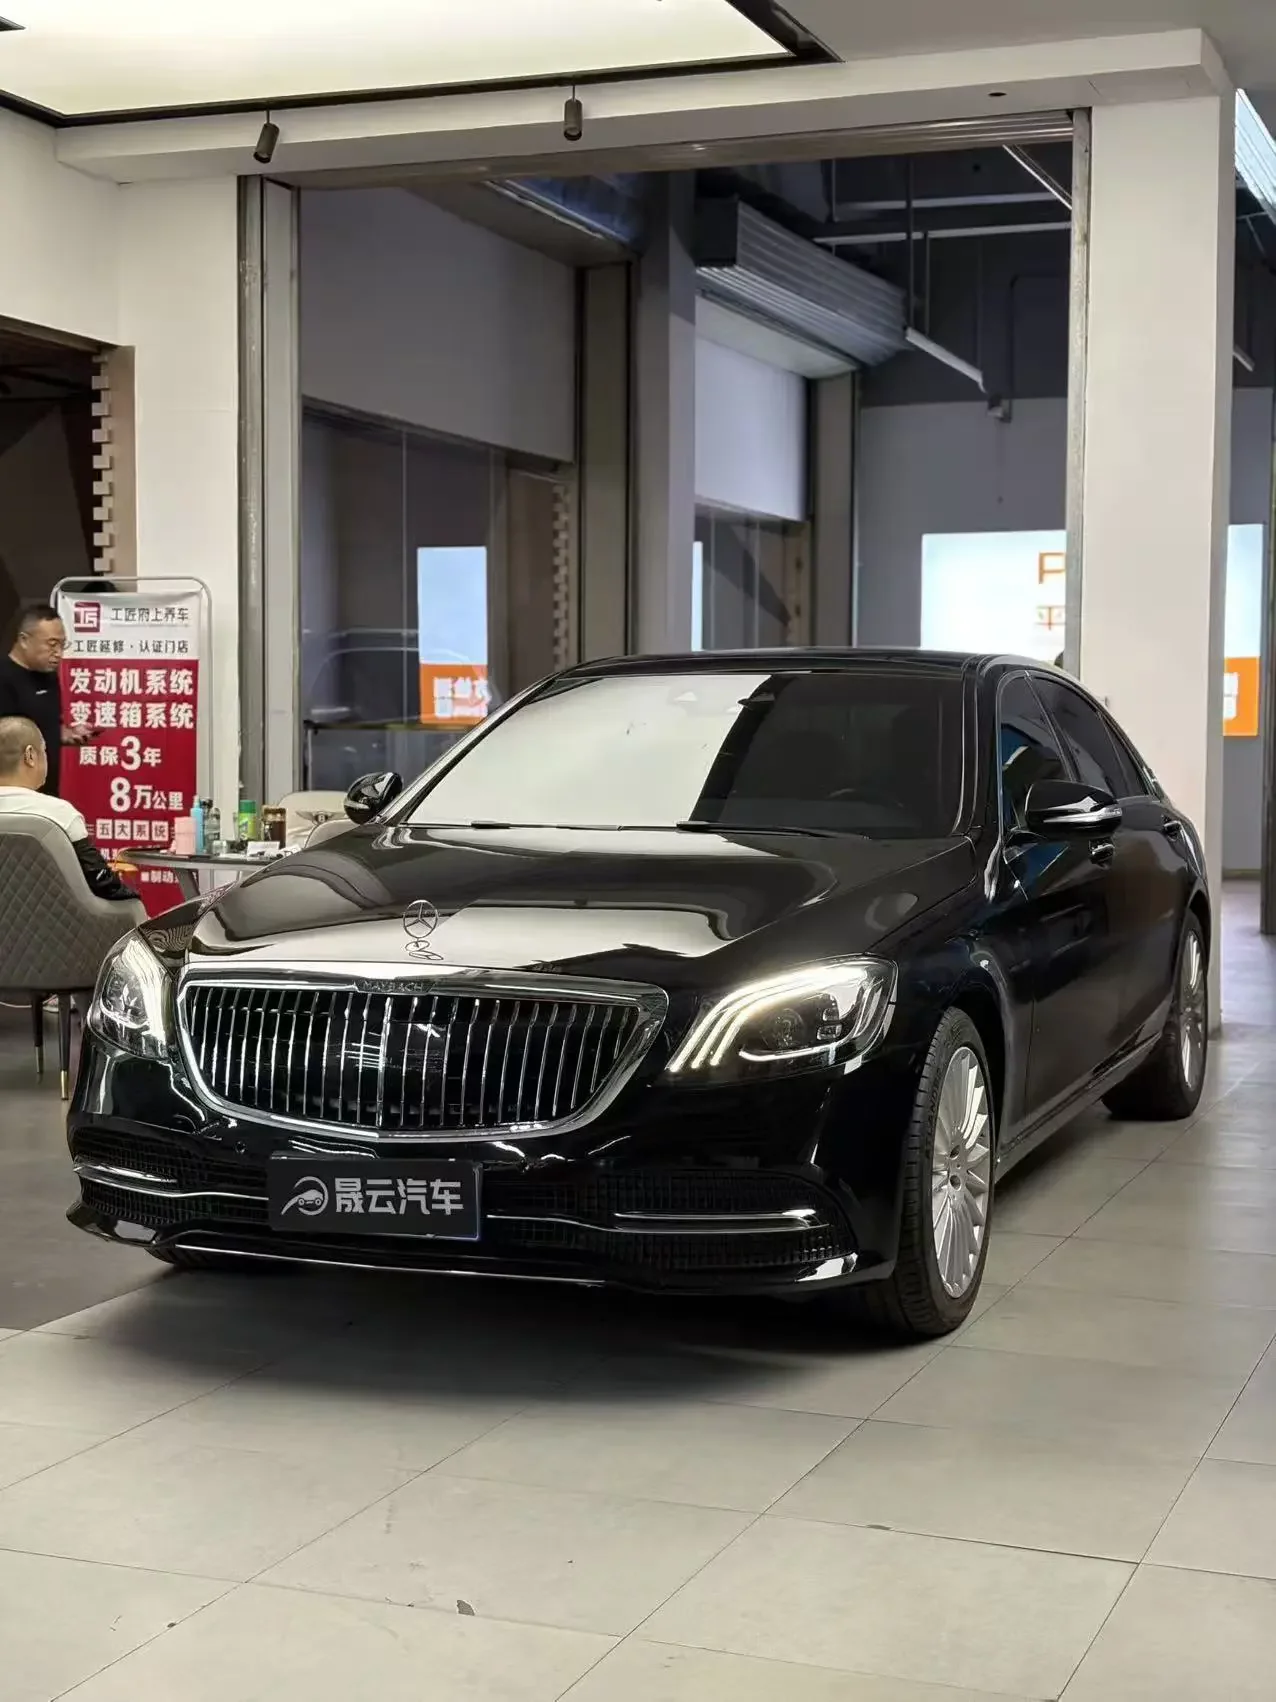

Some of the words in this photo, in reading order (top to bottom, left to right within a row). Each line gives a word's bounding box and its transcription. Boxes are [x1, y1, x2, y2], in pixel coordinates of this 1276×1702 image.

[110, 607, 189, 622] 工匠府上养车
[69, 667, 194, 695] 发动机系统
[69, 700, 194, 729] 变速箱系统
[79, 735, 162, 771] 质保3年
[109, 776, 184, 812] 8万公里
[98, 822, 167, 839] 五大系统
[334, 1177, 464, 1216] 晟云汽车
